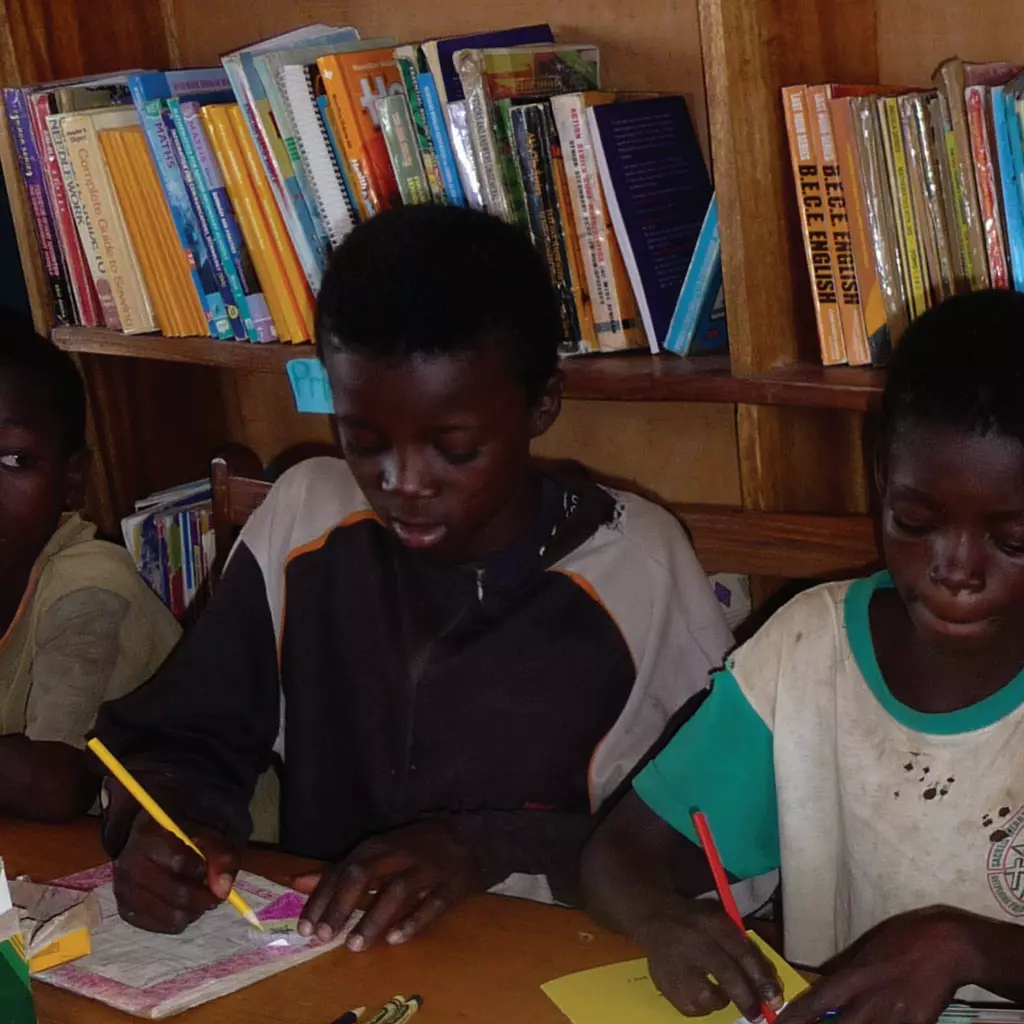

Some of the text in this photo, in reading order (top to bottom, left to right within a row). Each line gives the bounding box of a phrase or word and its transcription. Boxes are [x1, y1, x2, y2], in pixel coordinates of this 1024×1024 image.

[155, 121, 176, 168] MATHS
[570, 107, 582, 139] ACTION
[49, 118, 86, 226] NEEDLEWORK
[798, 162, 824, 225] B.E.C.E.
[821, 163, 848, 225] B.E.C.E.
[78, 147, 103, 216] Complete
[98, 218, 116, 256] Guide
[108, 259, 119, 274] to
[807, 228, 837, 305] ENGLISH
[832, 228, 861, 306] ENGLISH
